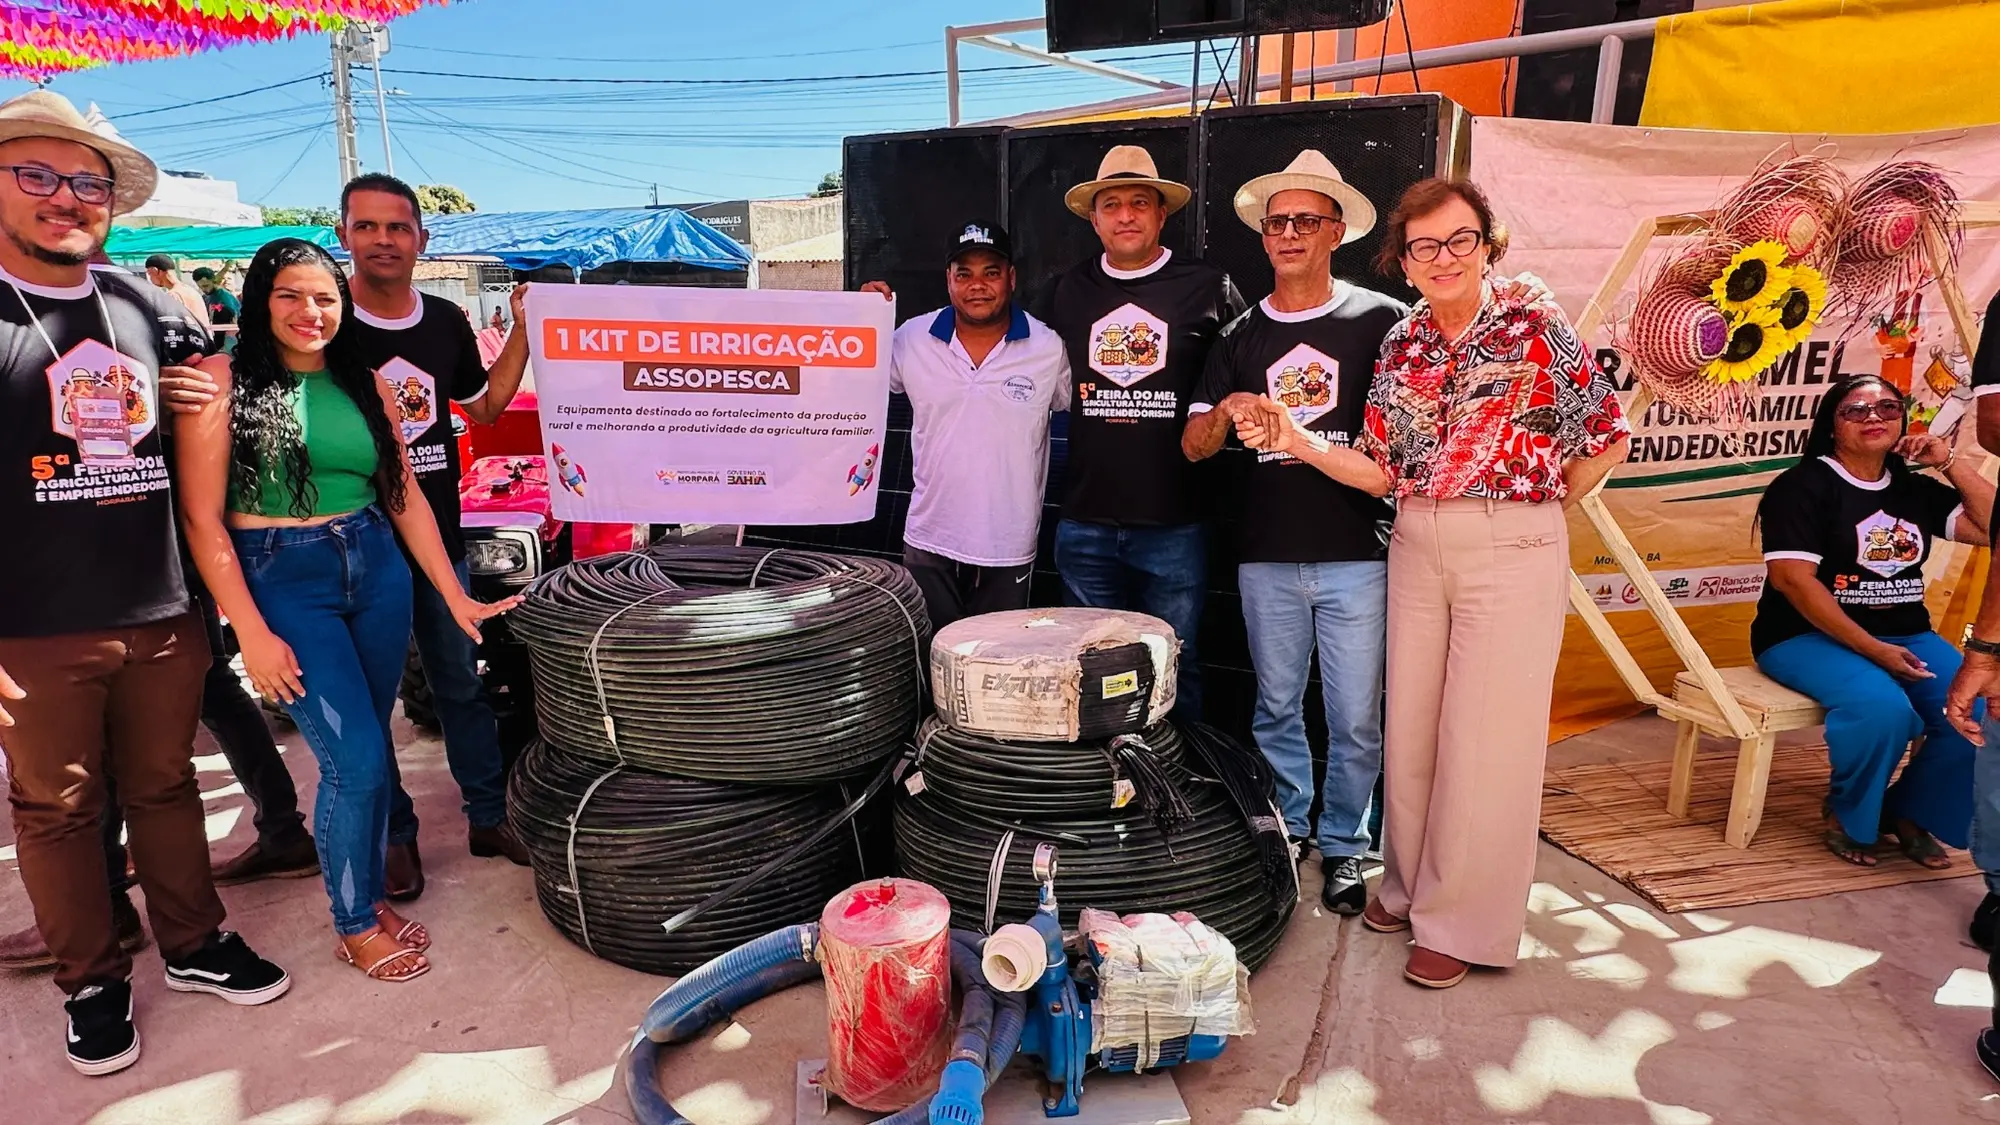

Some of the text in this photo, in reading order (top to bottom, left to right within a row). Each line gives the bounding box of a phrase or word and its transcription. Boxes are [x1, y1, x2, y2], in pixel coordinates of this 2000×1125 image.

[556, 328, 864, 364] 1 KIT DE IRRIGAÇÃO
[1758, 341, 1850, 386] MEL
[633, 367, 791, 390] ASSOPESCA
[1096, 390, 1131, 400] FEIRA
[1132, 390, 1153, 400] DO
[1154, 391, 1178, 401] MEL
[1136, 400, 1177, 409] FAMILIAR
[557, 404, 867, 422] Equipamento destinado ao fortalecimento da produção
[548, 421, 574, 430] rural
[576, 423, 583, 431] e
[586, 422, 655, 432] melhorando
[658, 424, 666, 432] a
[668, 423, 747, 434] produtividade
[749, 425, 764, 434] da
[766, 426, 829, 437] agricultura
[1327, 431, 1350, 441] MEL
[417, 446, 432, 456] DO
[135, 456, 155, 470] DO
[35, 473, 140, 490] AGRICULTURA
[678, 475, 720, 483] MORPARÁ
[727, 475, 767, 485] BAHIA
[35, 491, 47, 502] E
[1646, 552, 1661, 562] BA
[1721, 574, 1764, 587] Banco do
[1860, 581, 1895, 590] FEIRA
[1895, 579, 1911, 588] DO
[1719, 585, 1761, 595] Nordeste
